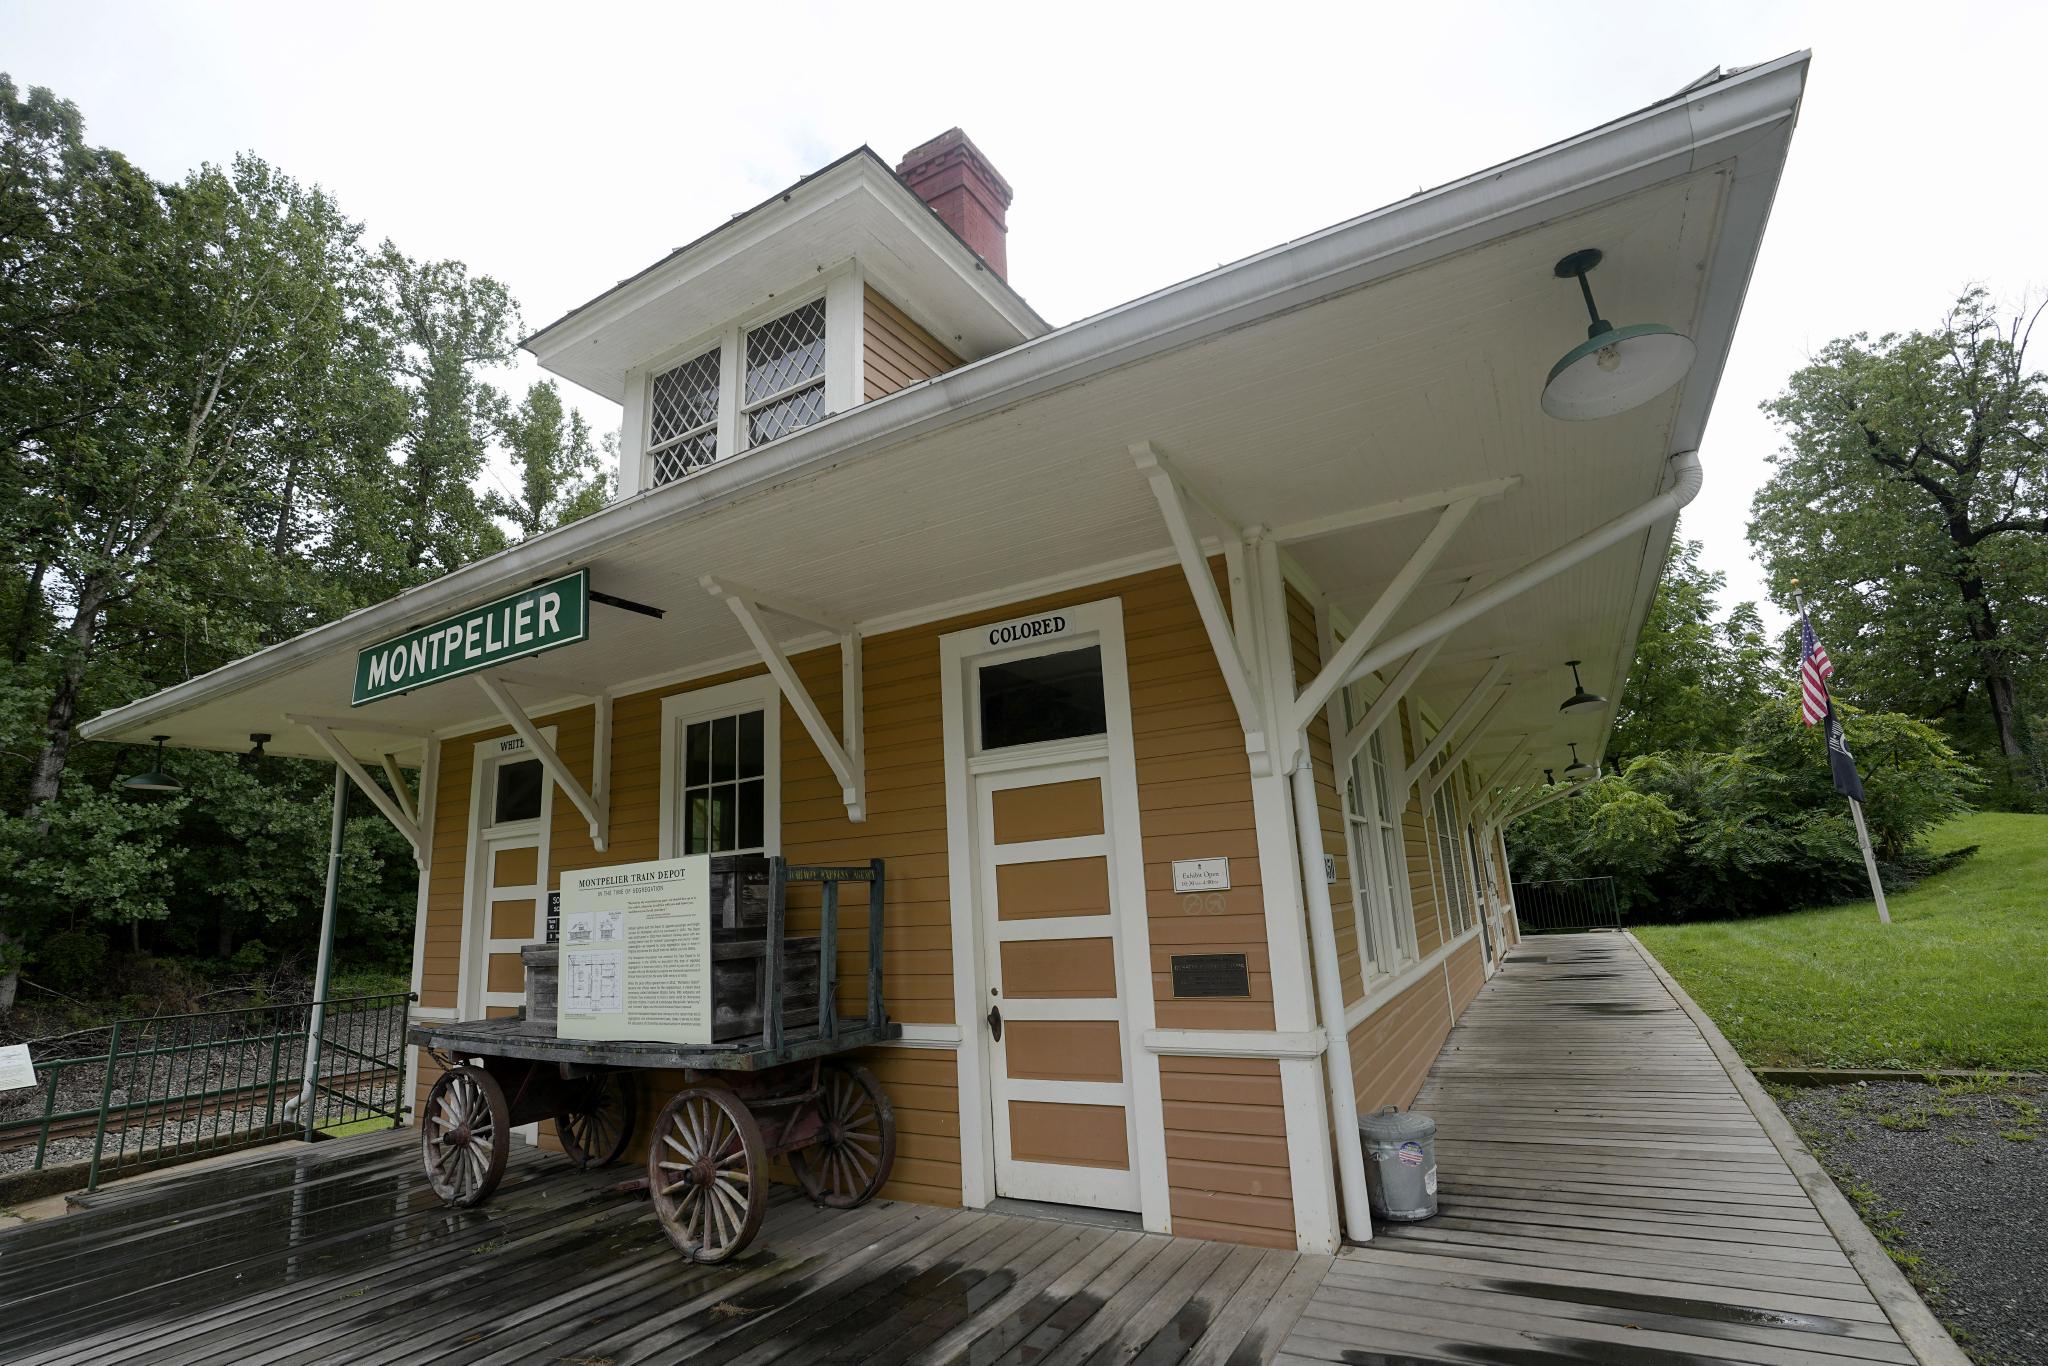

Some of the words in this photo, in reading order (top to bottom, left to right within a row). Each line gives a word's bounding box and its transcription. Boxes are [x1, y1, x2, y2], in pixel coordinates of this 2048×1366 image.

[989, 616, 1066, 645] COLORED
[367, 592, 561, 690] MONTPELIER
[500, 738, 525, 752] WHITE
[579, 874, 629, 888] MONTPELIER
[630, 871, 655, 883] TRAIN
[657, 868, 686, 880] DEPOT
[632, 885, 664, 894] SEGREGATION
